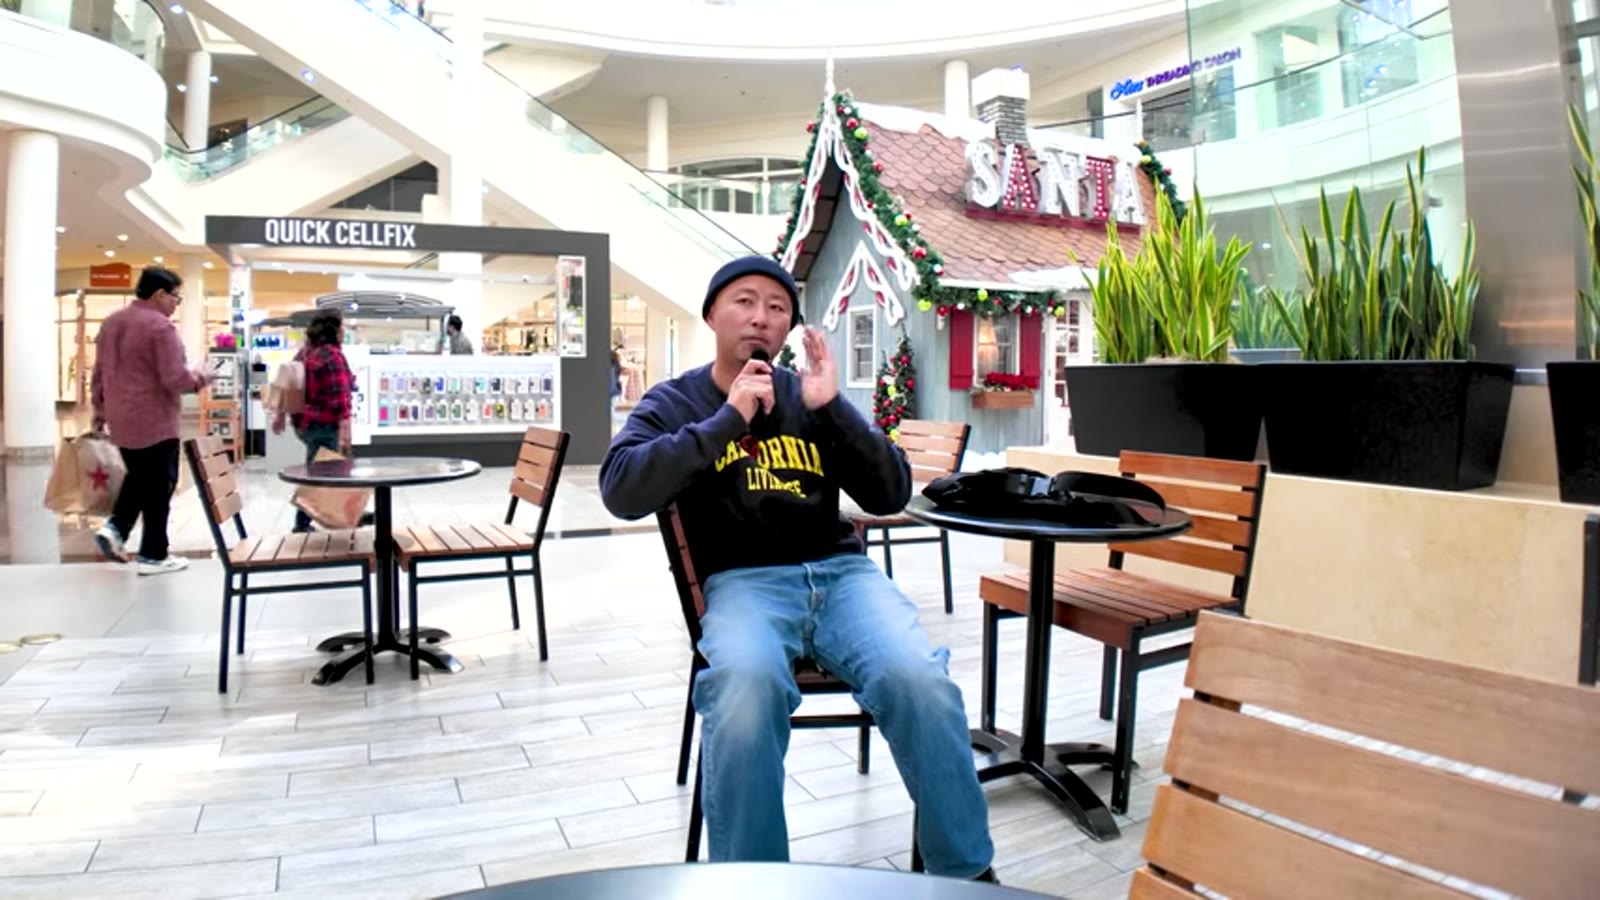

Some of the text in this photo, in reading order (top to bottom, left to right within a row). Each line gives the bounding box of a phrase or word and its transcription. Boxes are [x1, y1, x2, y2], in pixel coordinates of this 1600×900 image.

[965, 138, 1146, 225] SANTA
[265, 218, 416, 248] QUICK CELLFIX
